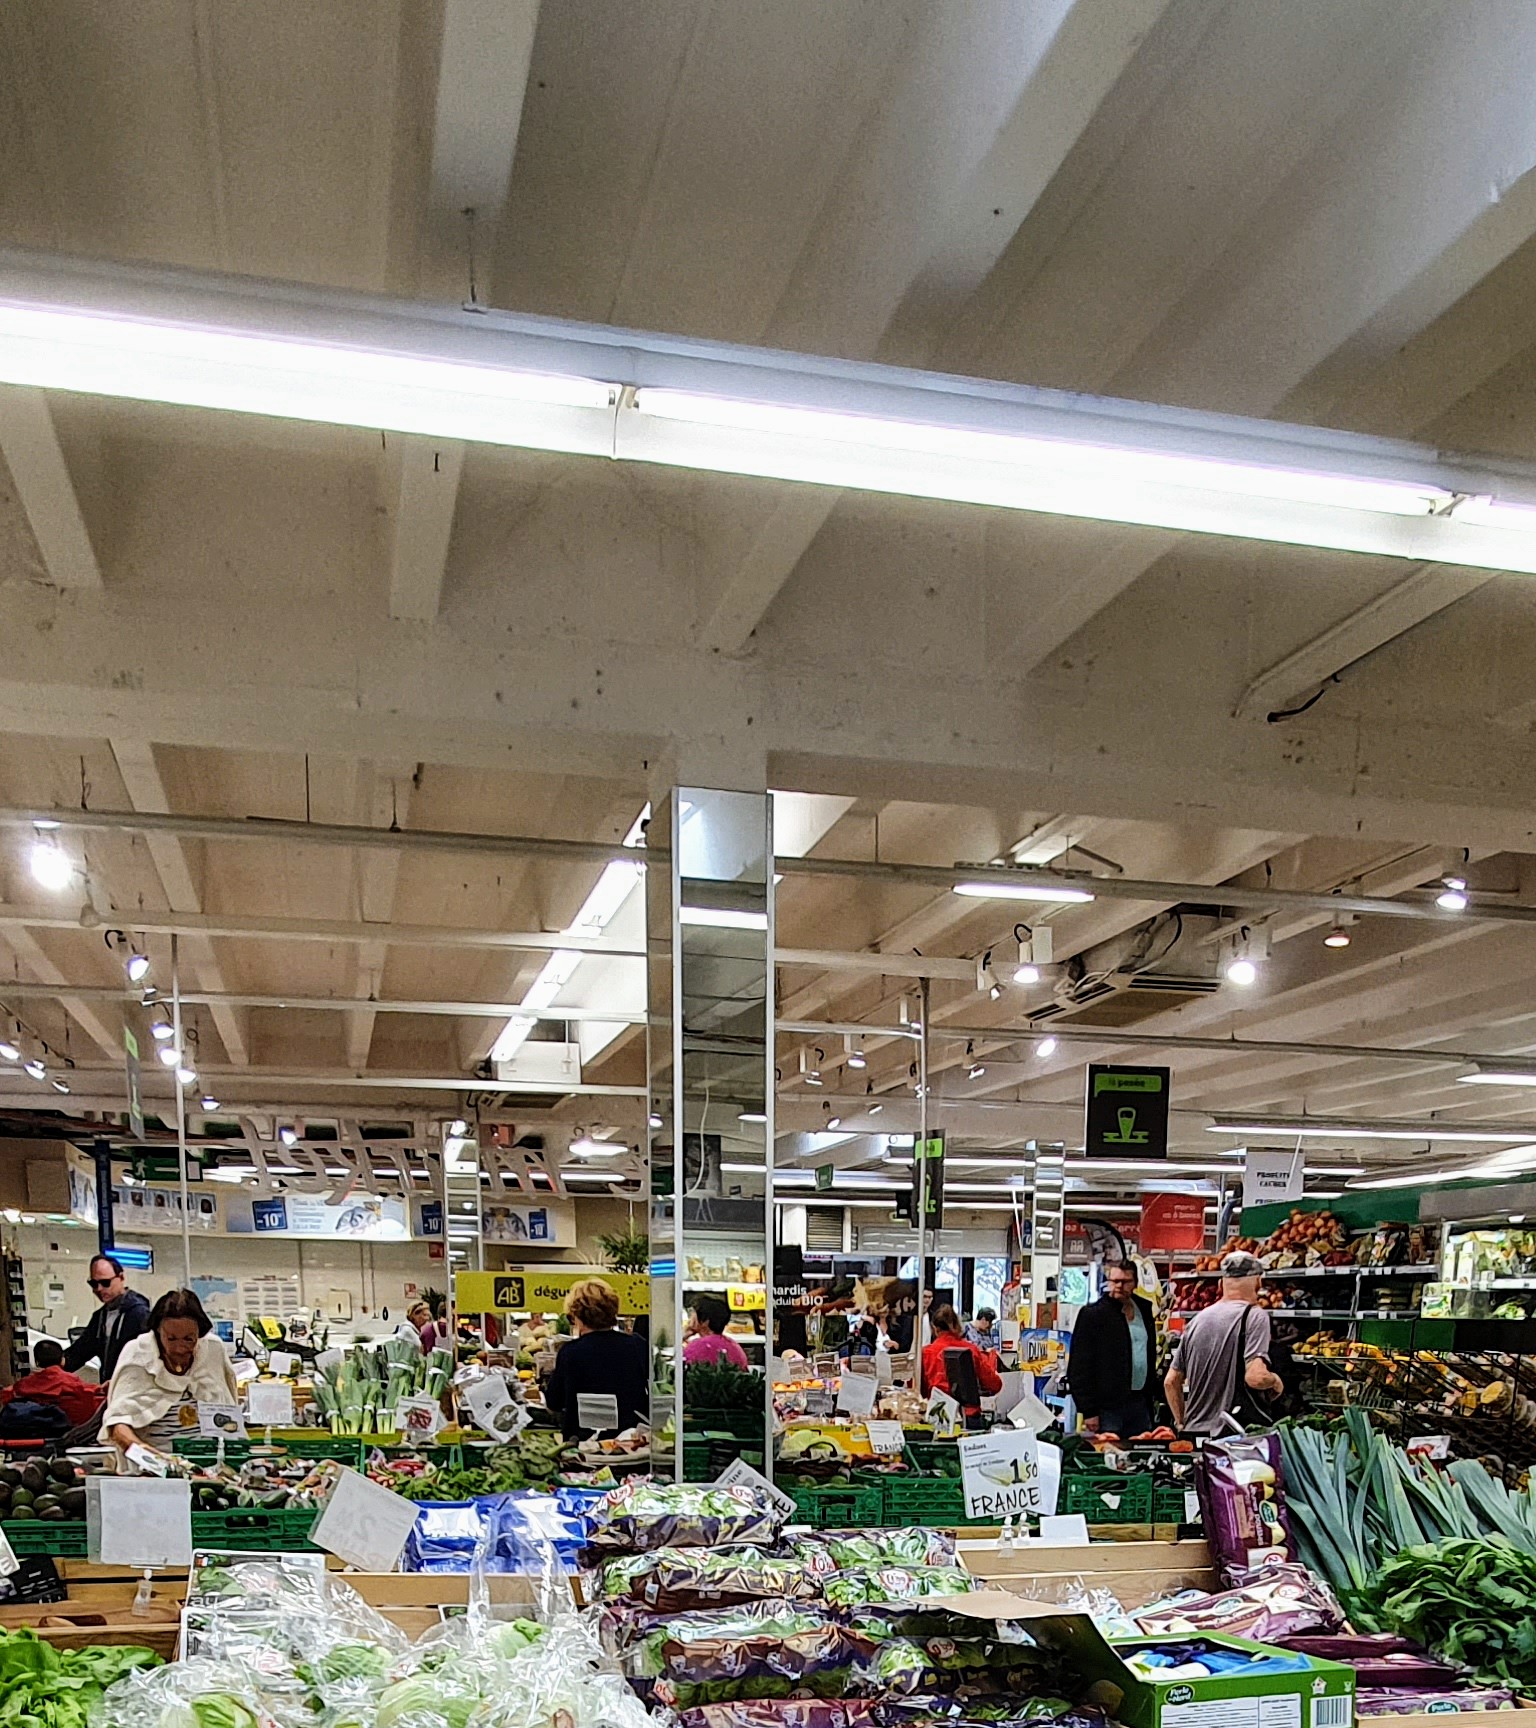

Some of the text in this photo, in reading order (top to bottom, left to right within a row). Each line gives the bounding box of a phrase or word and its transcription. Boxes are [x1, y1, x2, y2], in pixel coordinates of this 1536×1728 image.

[497, 1281, 521, 1305] AB
[534, 1285, 571, 1300] dégu
[971, 1487, 1041, 1516] FRANCE
